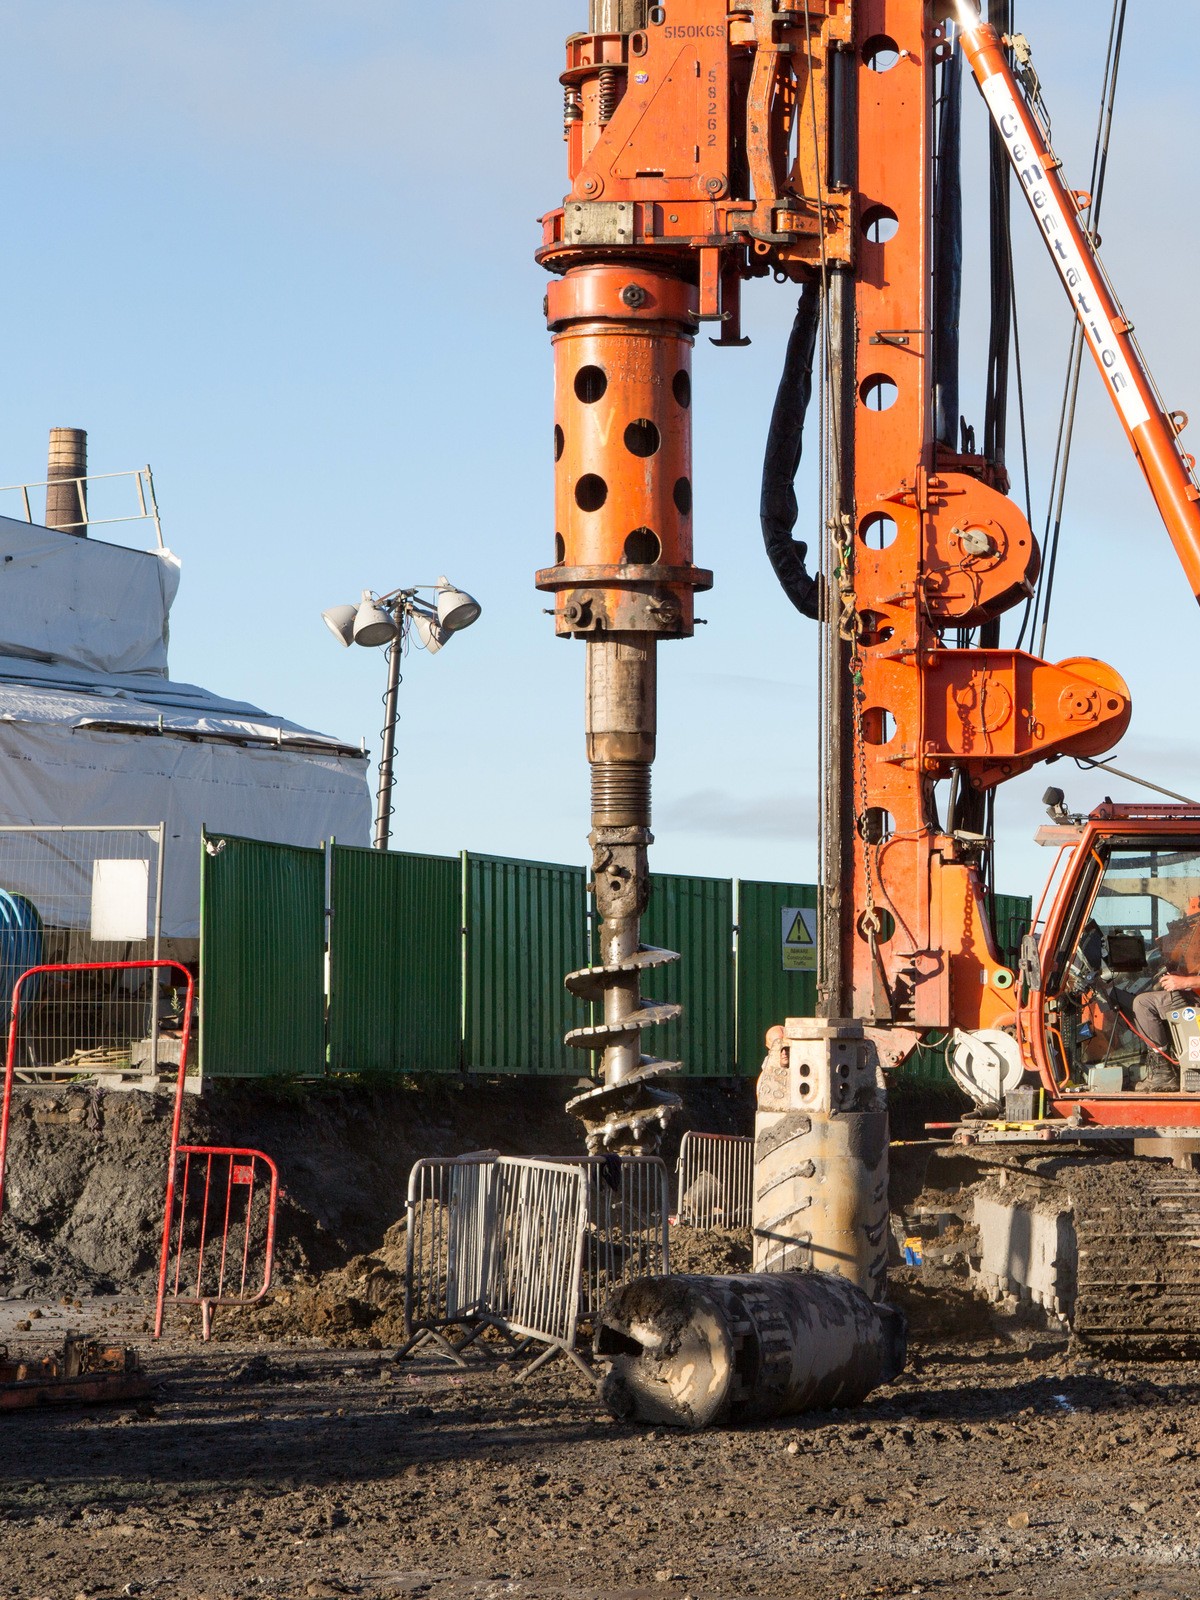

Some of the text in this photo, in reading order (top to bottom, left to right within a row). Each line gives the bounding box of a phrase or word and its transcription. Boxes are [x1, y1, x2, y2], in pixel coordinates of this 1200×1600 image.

[664, 26, 725, 38] 5150KGS
[707, 70, 717, 146] 58262
[1000, 114, 1127, 394] Cementation
